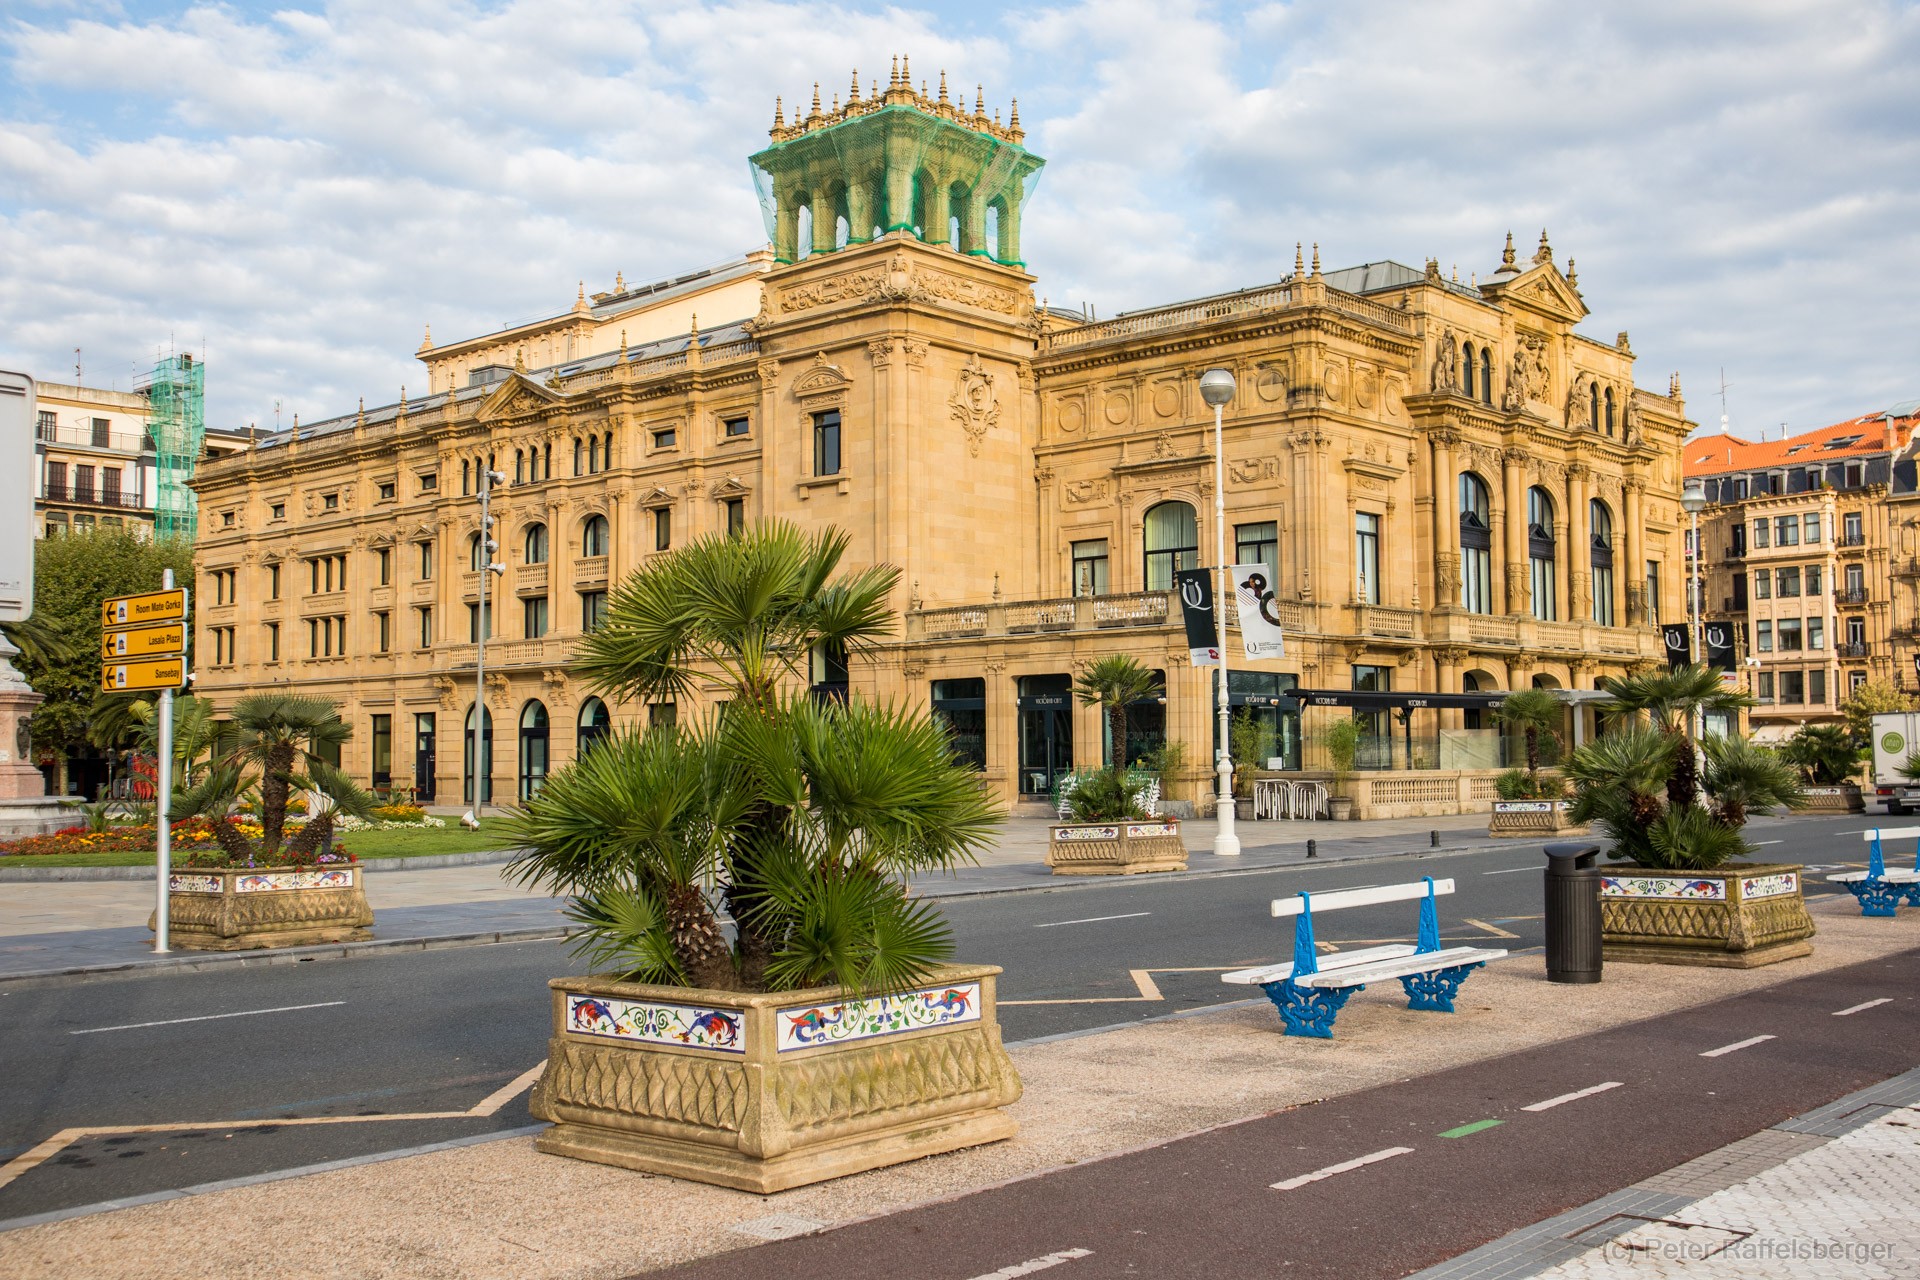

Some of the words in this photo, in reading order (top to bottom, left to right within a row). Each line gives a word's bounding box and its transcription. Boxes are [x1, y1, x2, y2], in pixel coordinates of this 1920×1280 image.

[136, 604, 150, 614] Room
[151, 602, 164, 612] Mate
[165, 600, 181, 610] Gorka
[148, 636, 165, 646] Lasala
[166, 634, 180, 644] Plaza
[155, 668, 179, 679] Sansebay
